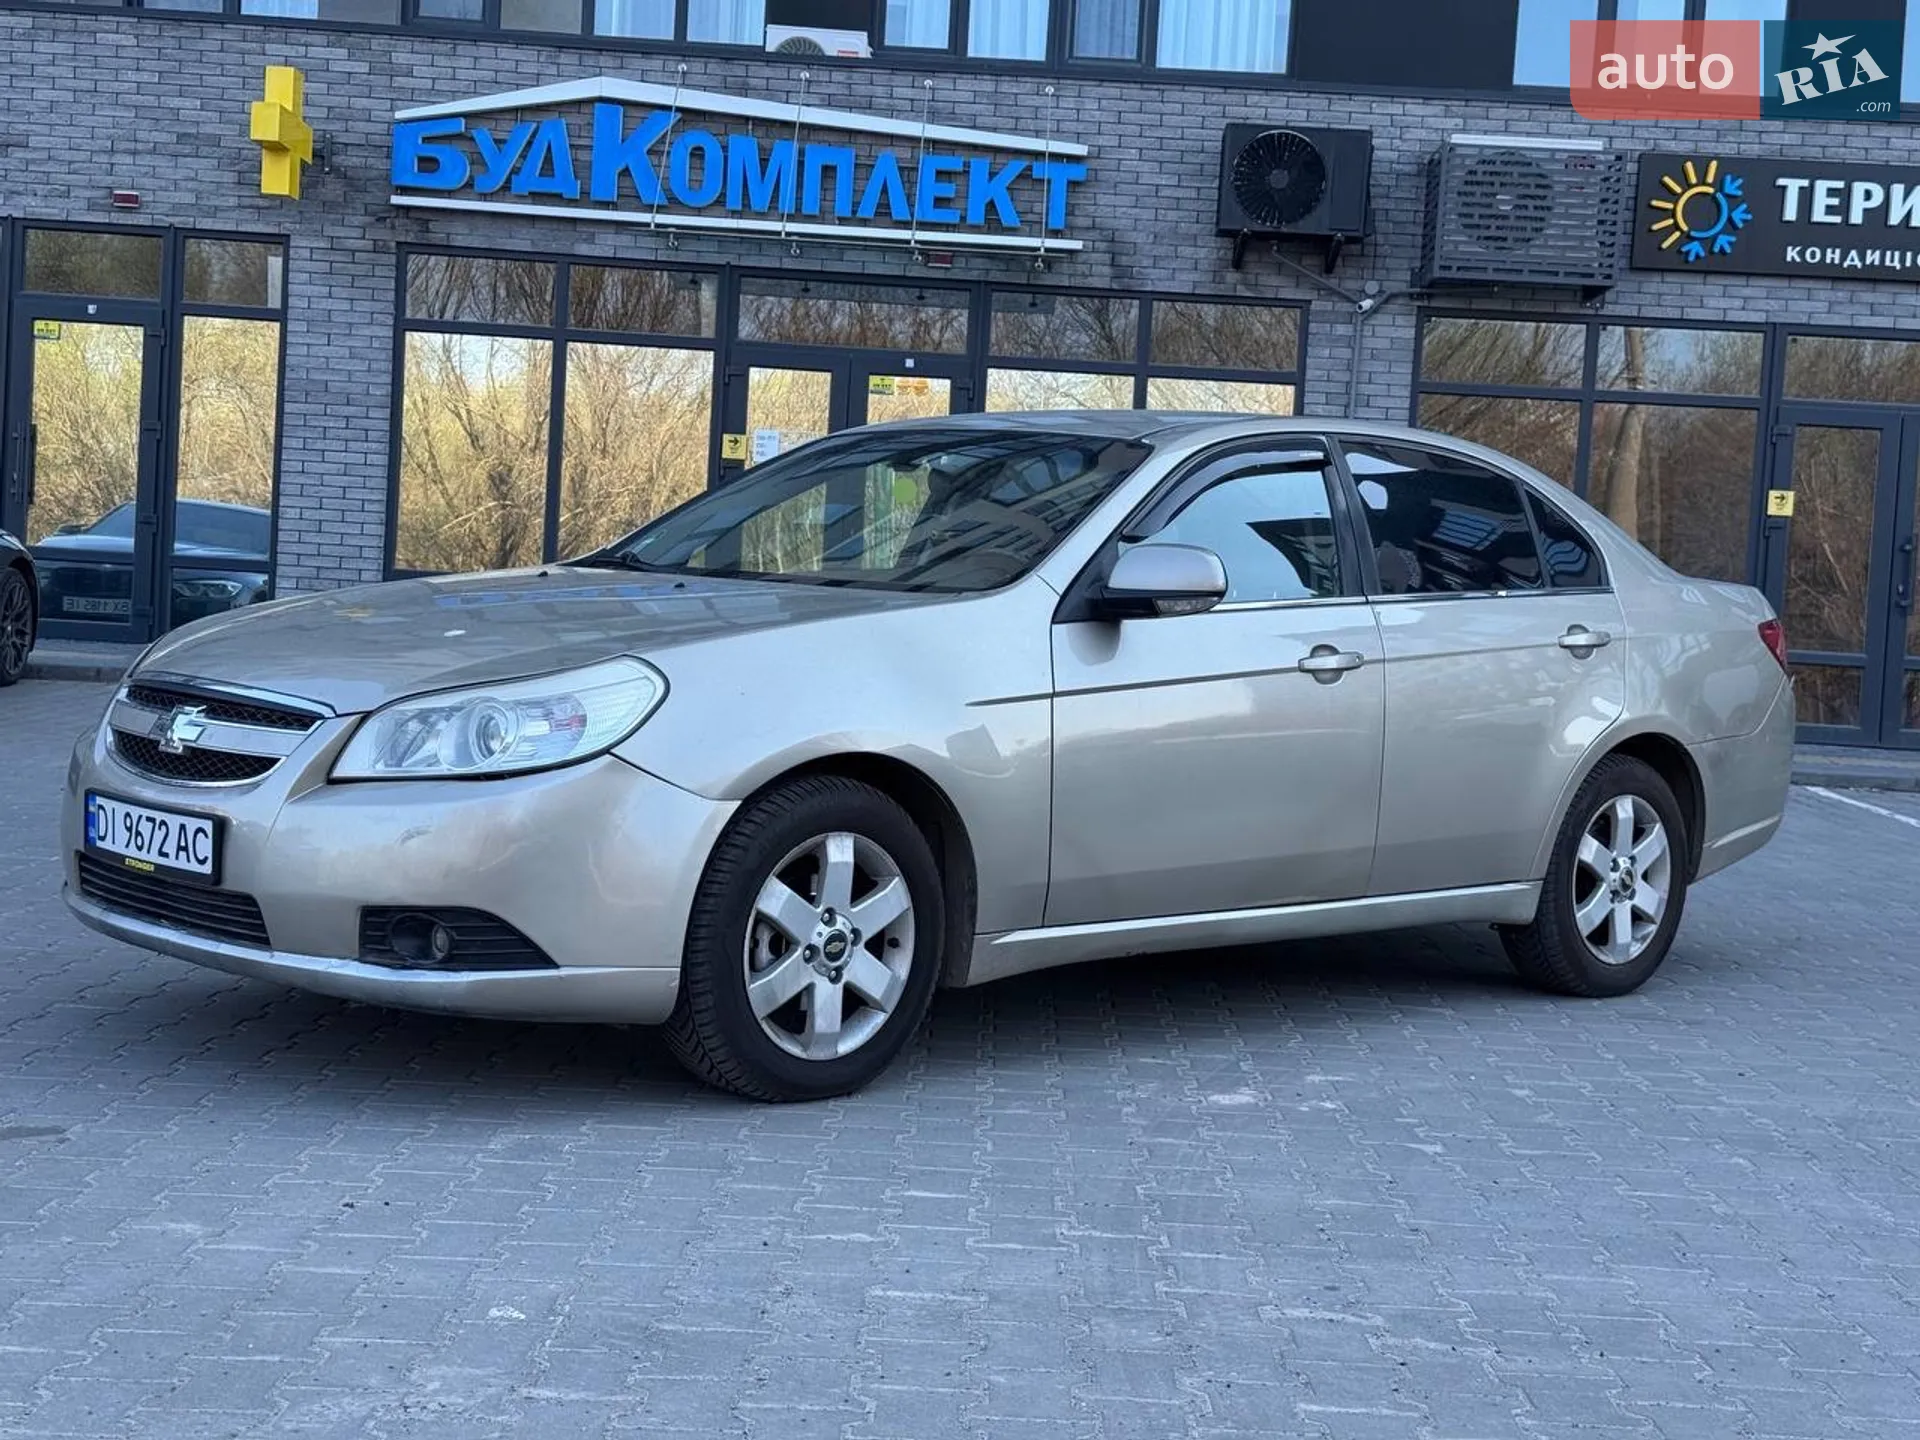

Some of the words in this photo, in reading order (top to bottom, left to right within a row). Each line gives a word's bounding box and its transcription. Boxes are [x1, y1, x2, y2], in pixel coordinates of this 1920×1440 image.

[1786, 246, 1920, 270] КОНДИЦІ
[97, 804, 116, 845] DI
[123, 811, 170, 859] 9672
[175, 823, 209, 866] AC
